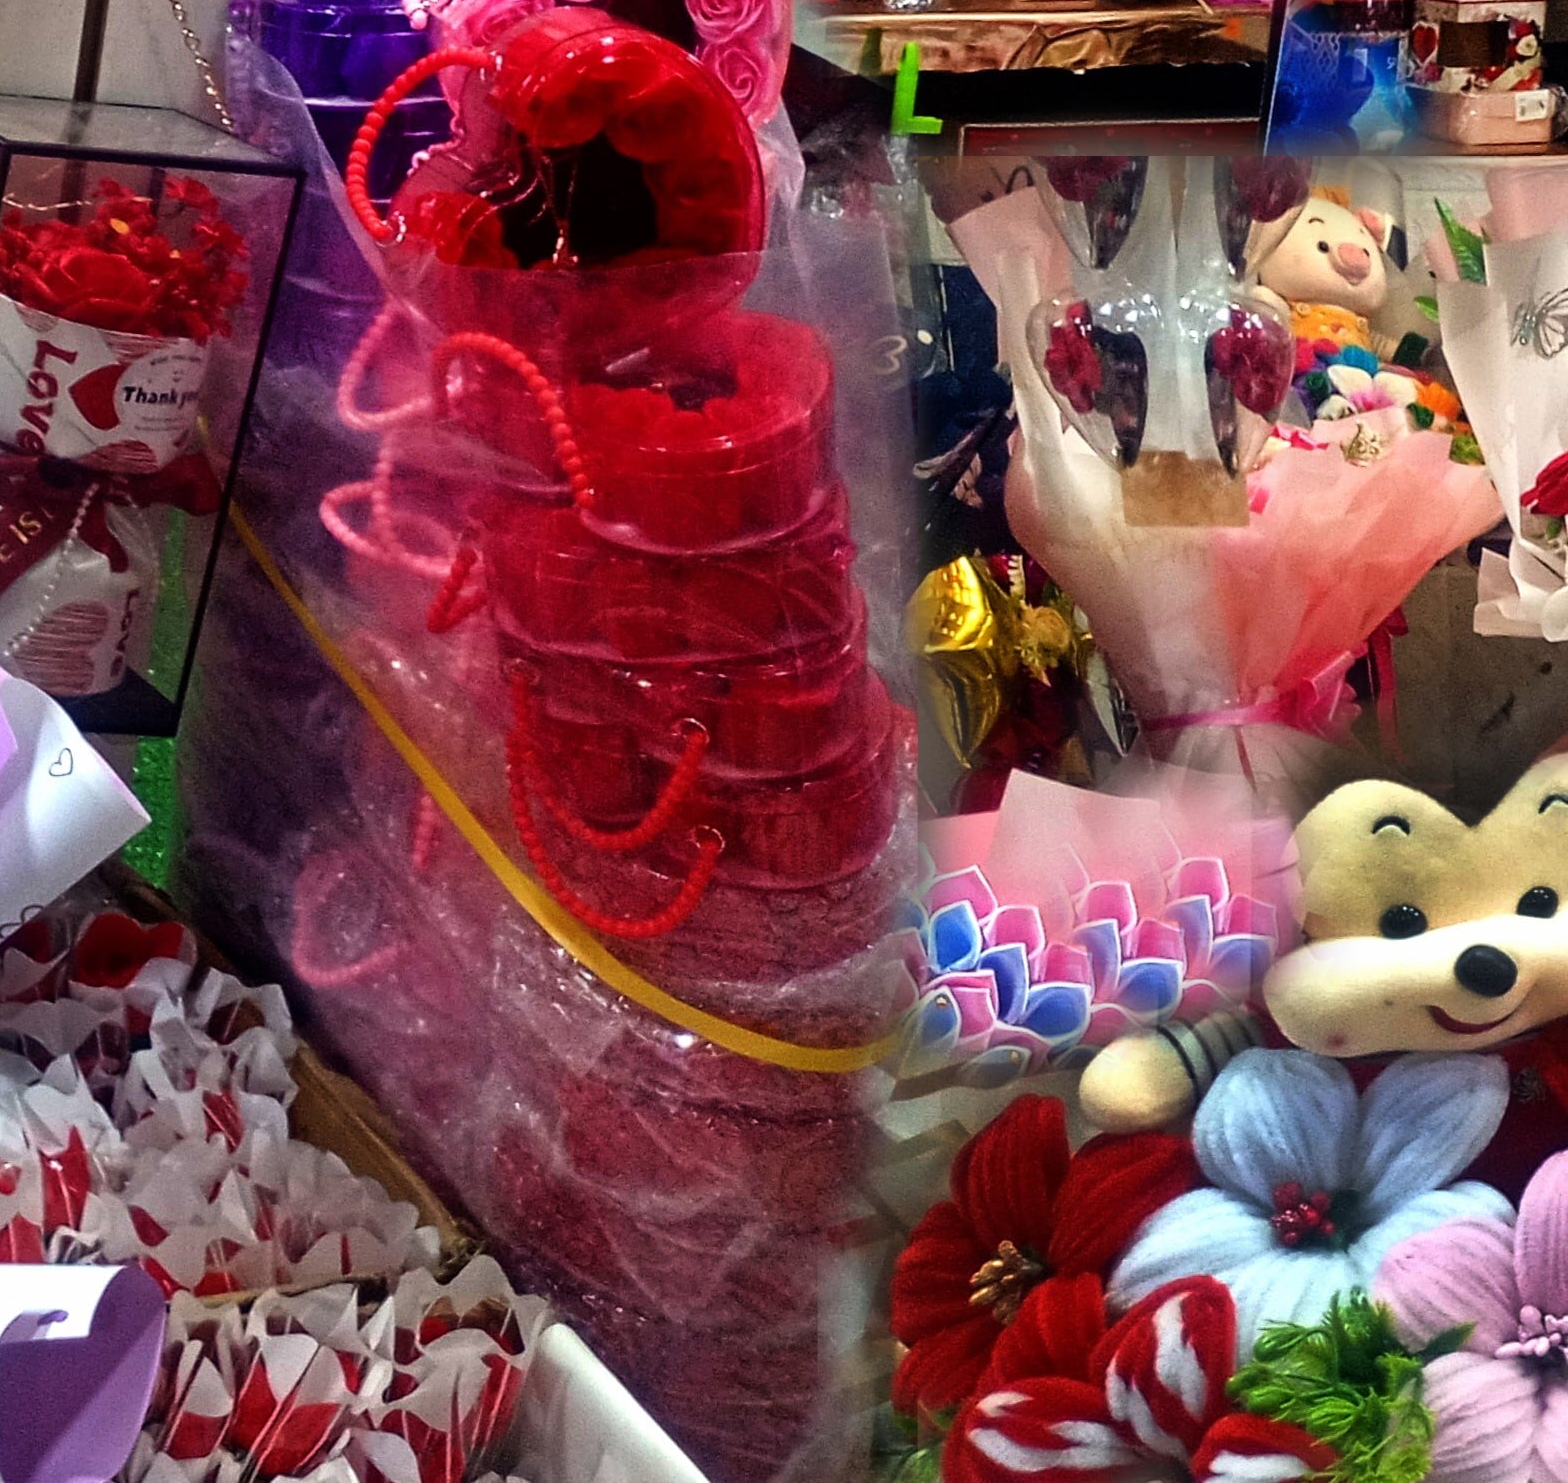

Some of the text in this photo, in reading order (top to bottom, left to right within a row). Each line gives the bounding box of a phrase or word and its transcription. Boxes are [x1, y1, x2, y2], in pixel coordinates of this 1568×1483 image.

[16, 340, 78, 455] Love
[123, 386, 177, 405] Thank
[9, 511, 43, 545] IS
